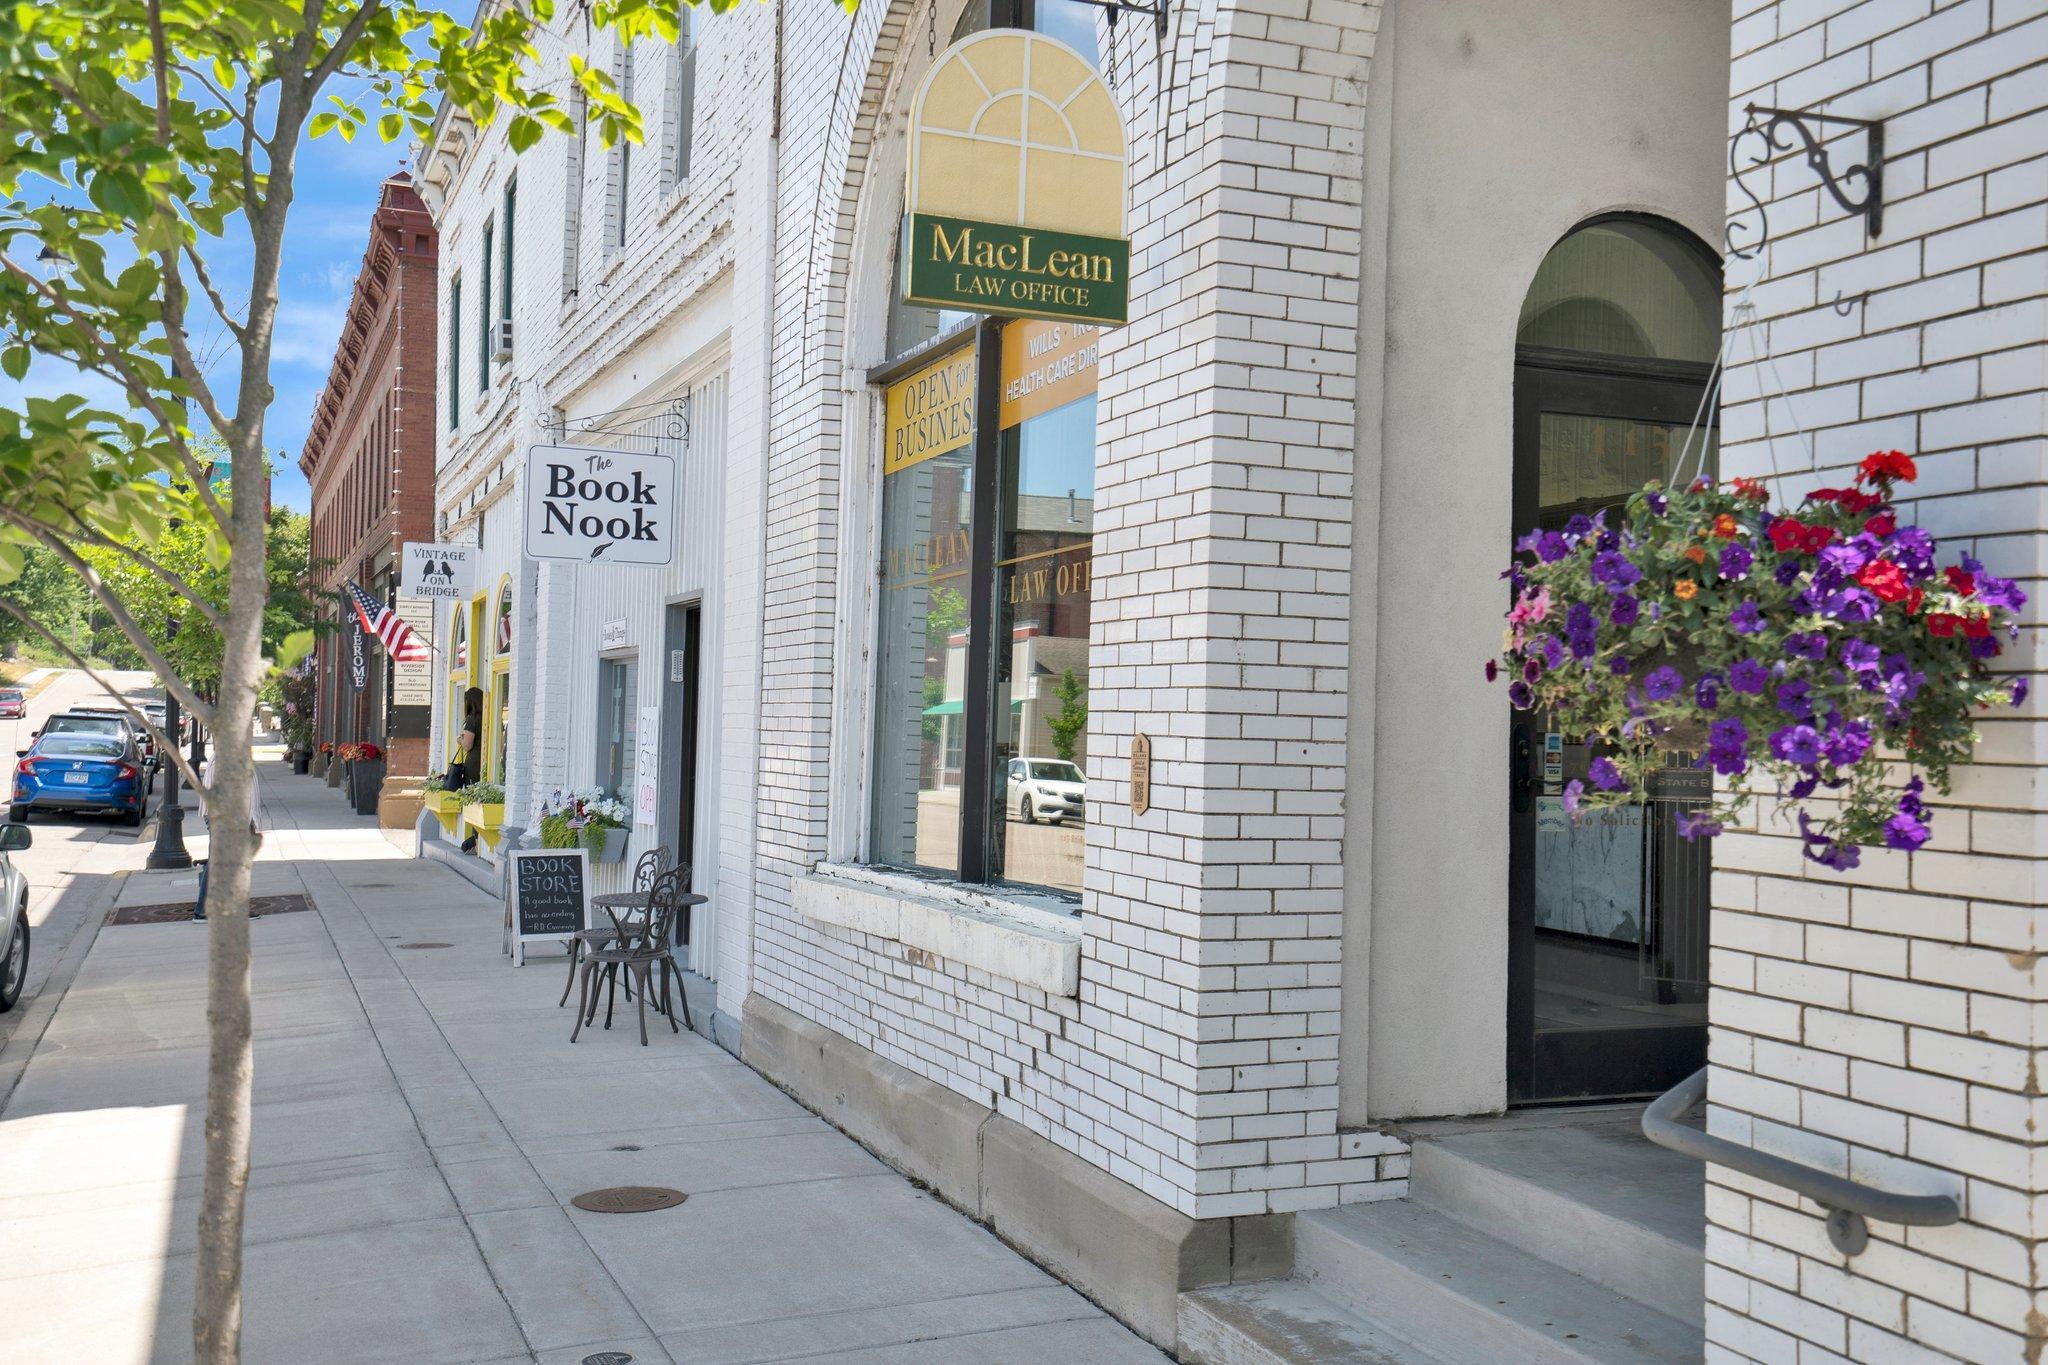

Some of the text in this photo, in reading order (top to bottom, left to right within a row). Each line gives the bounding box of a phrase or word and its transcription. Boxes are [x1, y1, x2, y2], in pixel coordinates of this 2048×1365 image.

[929, 223, 1114, 283] MacLean
[954, 272, 1090, 307] LAW OFFICE
[1029, 326, 1061, 359] WILLS
[904, 363, 972, 420] OPEN for
[1005, 368, 1044, 403] HEALTH
[1046, 353, 1076, 385] CARE
[583, 454, 613, 475] The
[545, 463, 658, 506] Book
[541, 500, 659, 542] Nook
[413, 548, 466, 561] VINTAGE
[415, 585, 460, 598] BRIDGE
[429, 576, 445, 586] ON
[1010, 568, 1049, 604] LAW
[351, 624, 366, 688] JEROME
[1657, 777, 1697, 788] STATE
[1537, 816, 1565, 827] Member
[520, 858, 576, 875] BOOK
[519, 875, 581, 893] STORE
[531, 895, 551, 909] good
